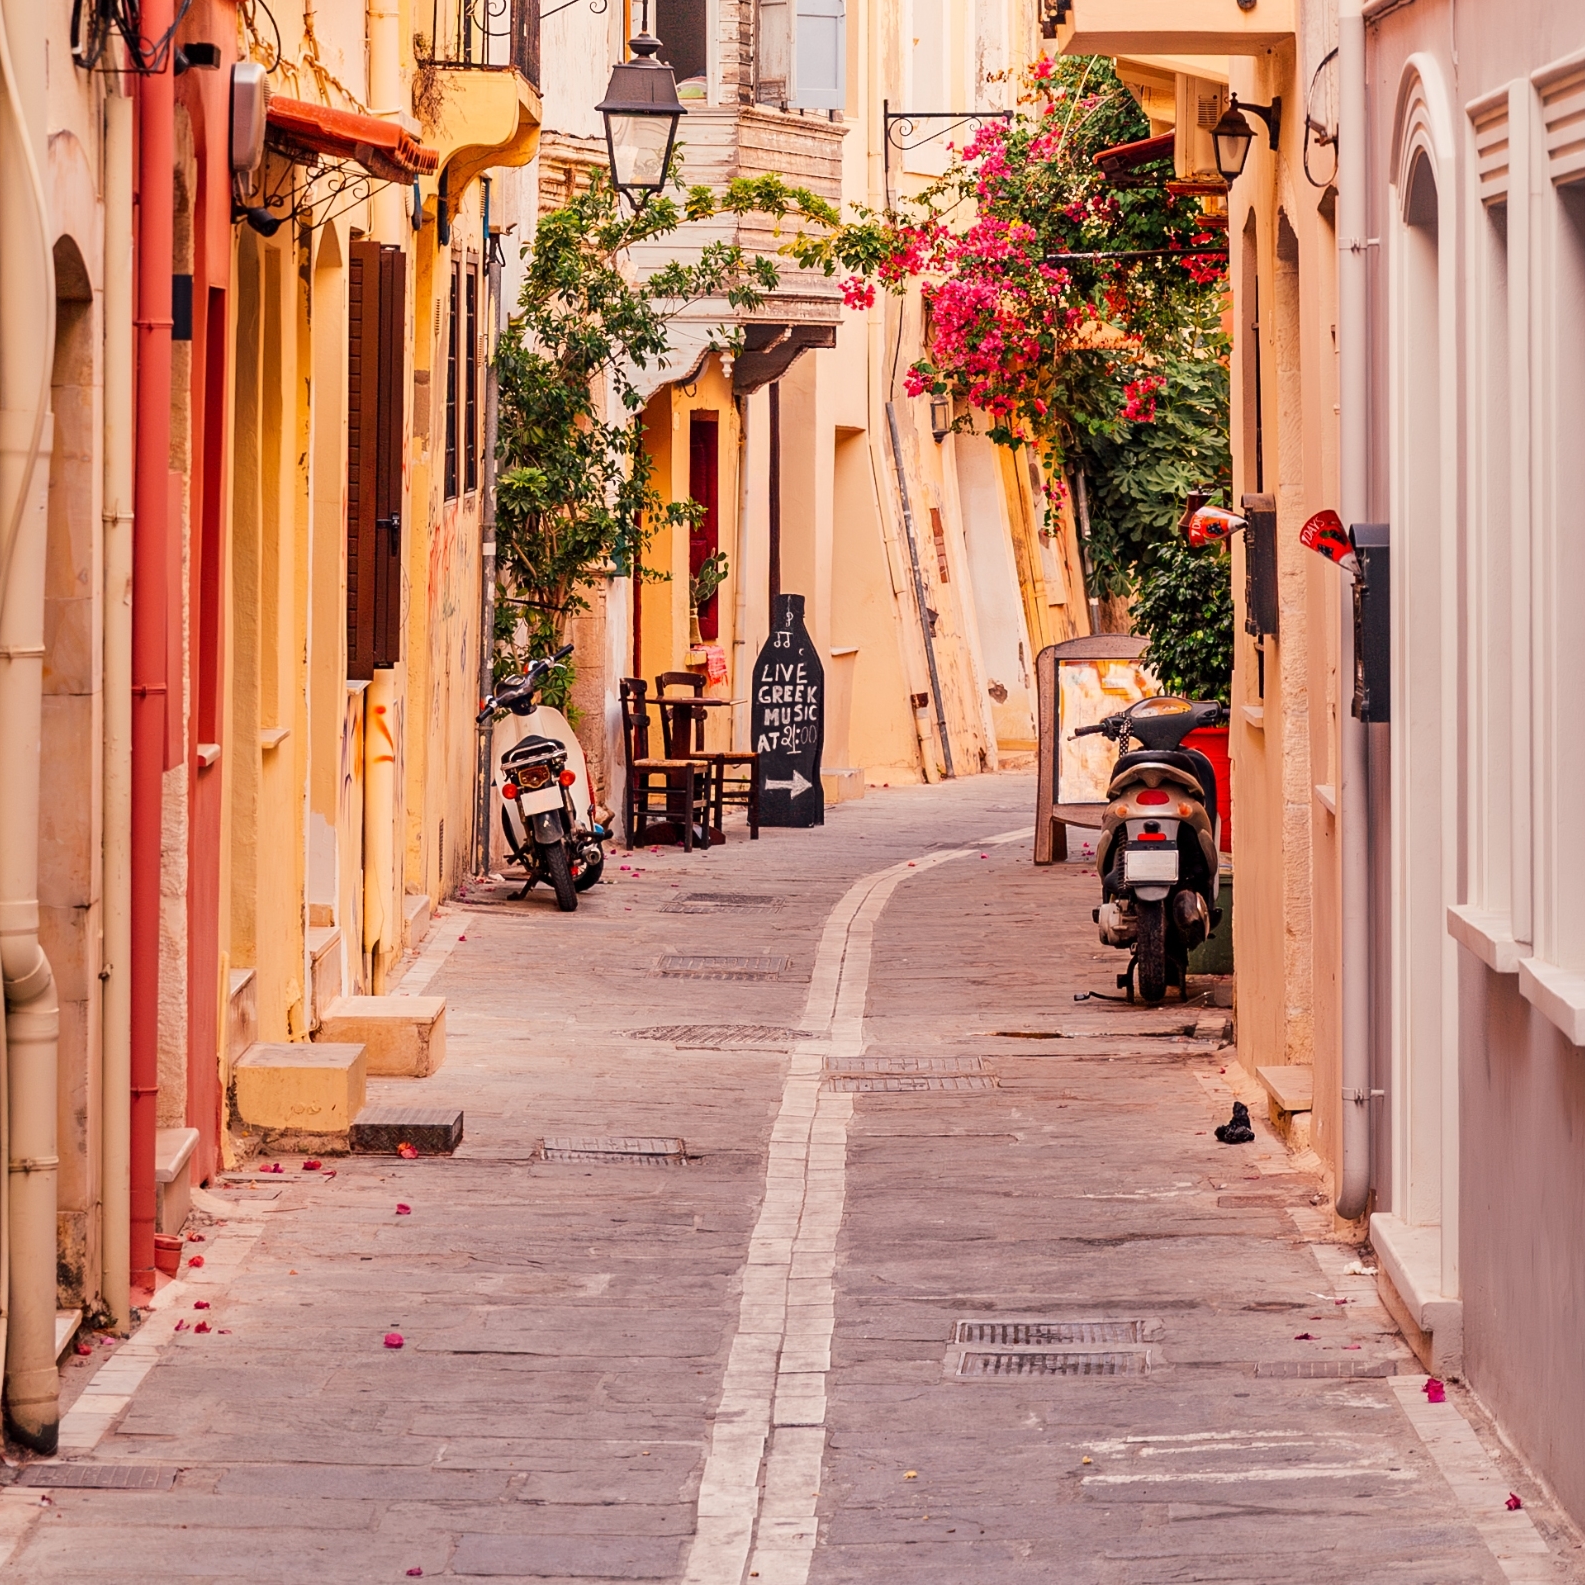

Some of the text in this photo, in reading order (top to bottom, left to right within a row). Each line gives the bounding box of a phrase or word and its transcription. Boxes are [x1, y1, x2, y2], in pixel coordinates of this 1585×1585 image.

[761, 663, 808, 684] LIVE
[758, 685, 818, 704] GREEK
[764, 704, 818, 726] MUSIC
[757, 723, 818, 755] AT 21:00
